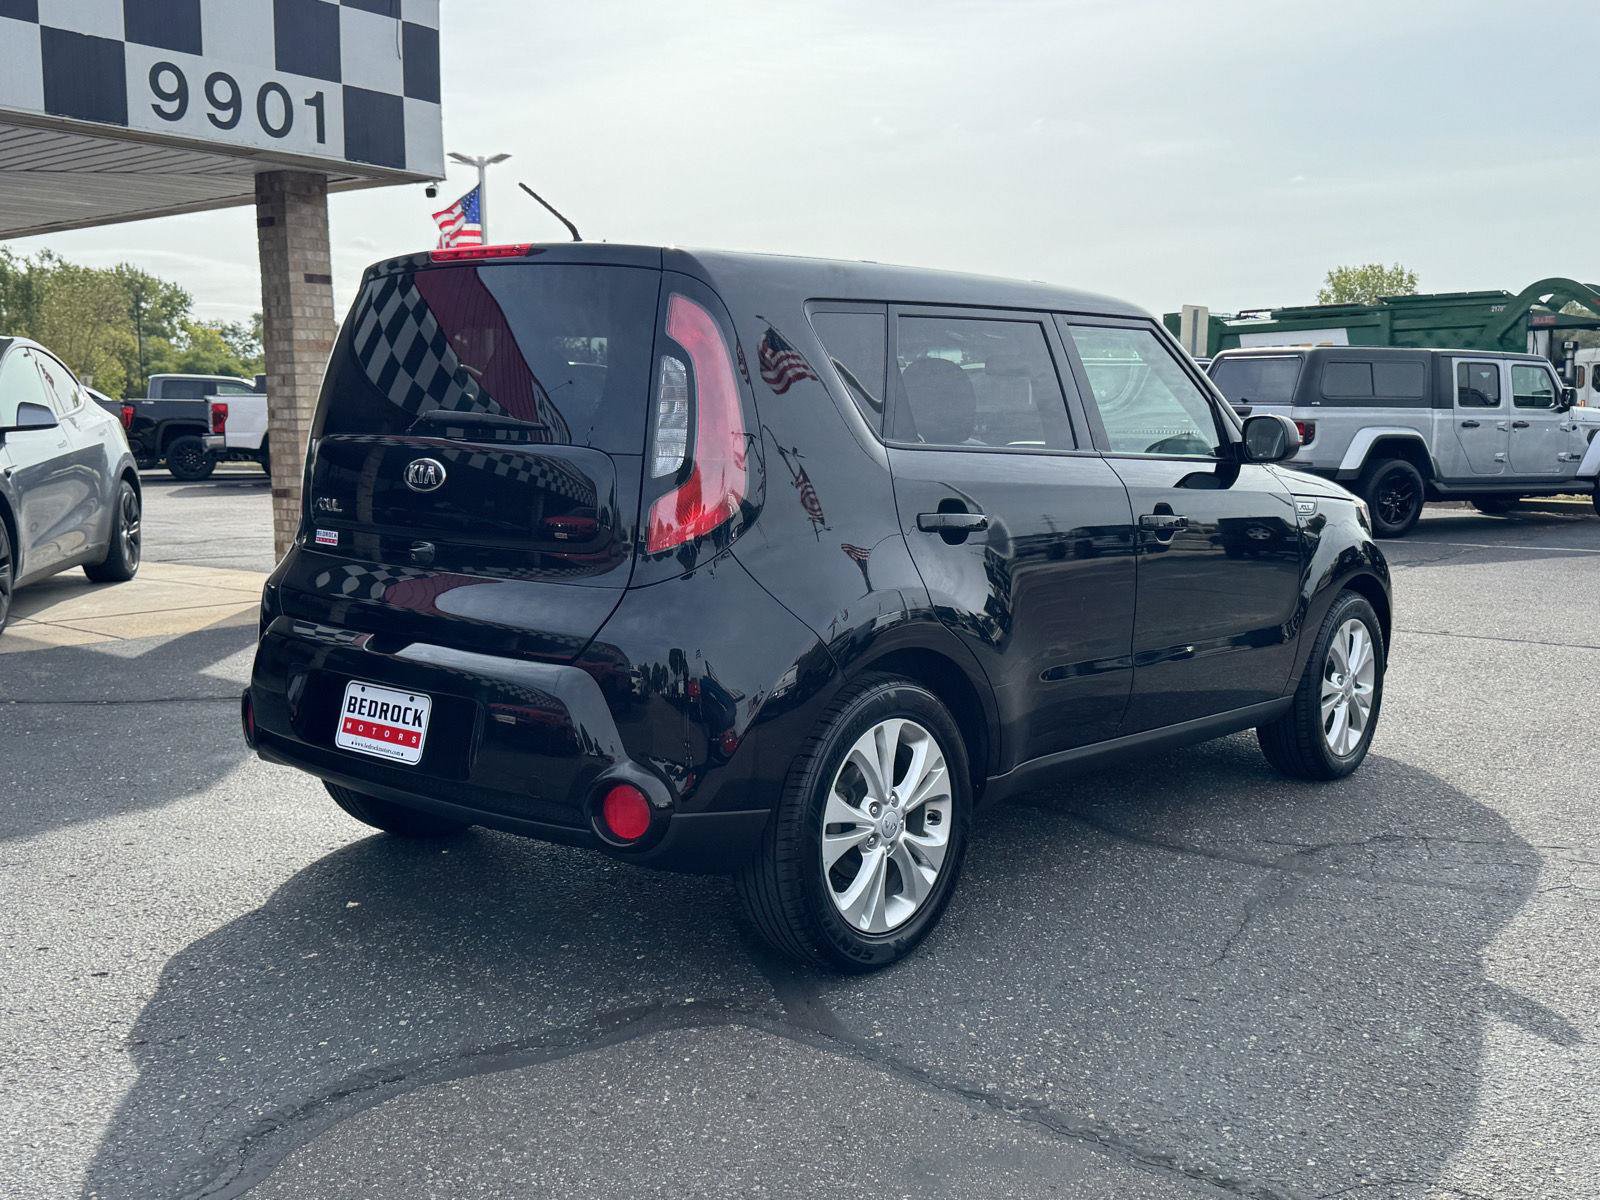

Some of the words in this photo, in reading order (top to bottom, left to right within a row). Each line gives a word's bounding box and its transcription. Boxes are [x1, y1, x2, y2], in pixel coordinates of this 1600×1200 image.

[149, 61, 326, 144] 9901
[408, 464, 437, 485] KIA
[346, 696, 424, 728] BEDROCK
[346, 722, 417, 744] MOTORS
